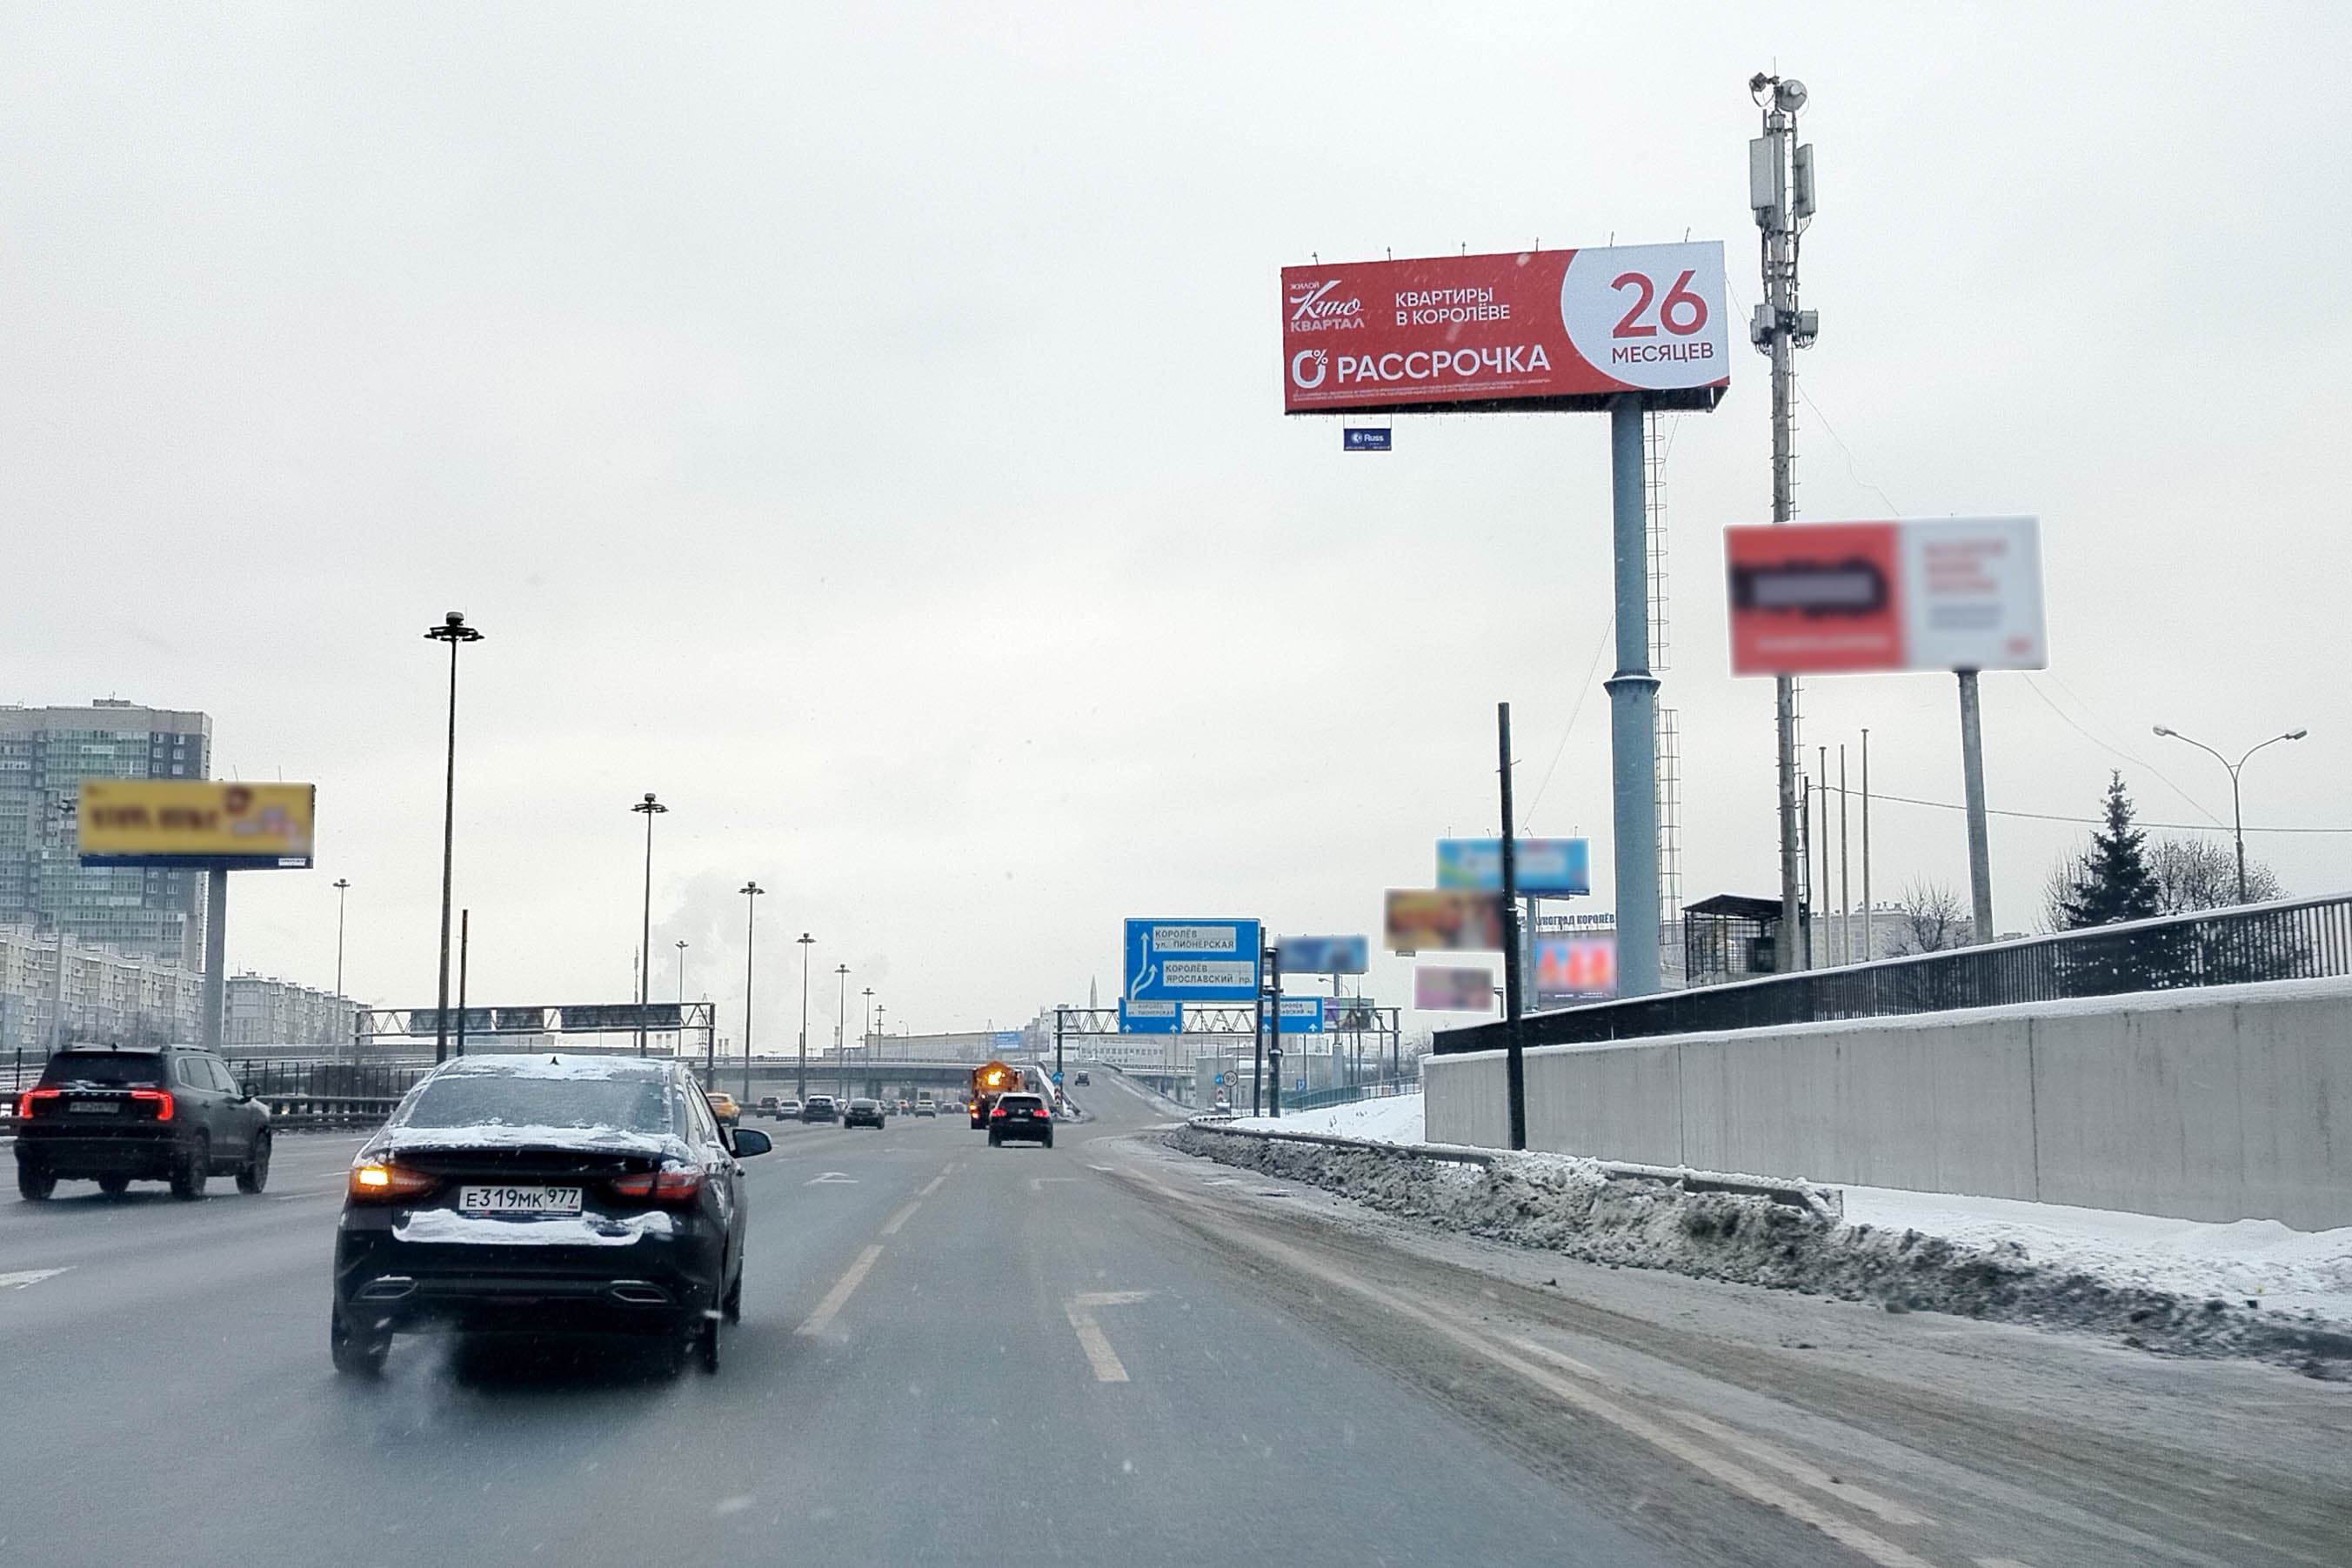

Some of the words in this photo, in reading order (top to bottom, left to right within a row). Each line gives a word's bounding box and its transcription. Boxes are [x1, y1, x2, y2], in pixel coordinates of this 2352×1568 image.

[1395, 287, 1493, 308] КВАРТИРЫ
[1610, 270, 1708, 339] 26
[1396, 310, 1408, 326] В
[1413, 303, 1511, 325] КОРОЛЁВЕ
[1290, 317, 1365, 332] КВАРТАЛ
[1612, 342, 1714, 364] МЕСЯЦЕВ
[1337, 344, 1552, 384] РАССРОЧКА
[1576, 912, 1615, 925] КОРОЛЁВ
[1154, 928, 1198, 938] КОРОЛЁВ
[1165, 964, 1208, 973] КОРОЛЁВ
[1166, 973, 1233, 984] ЯРОСЛАВСКИЙ
[547, 1189, 578, 1204] 977
